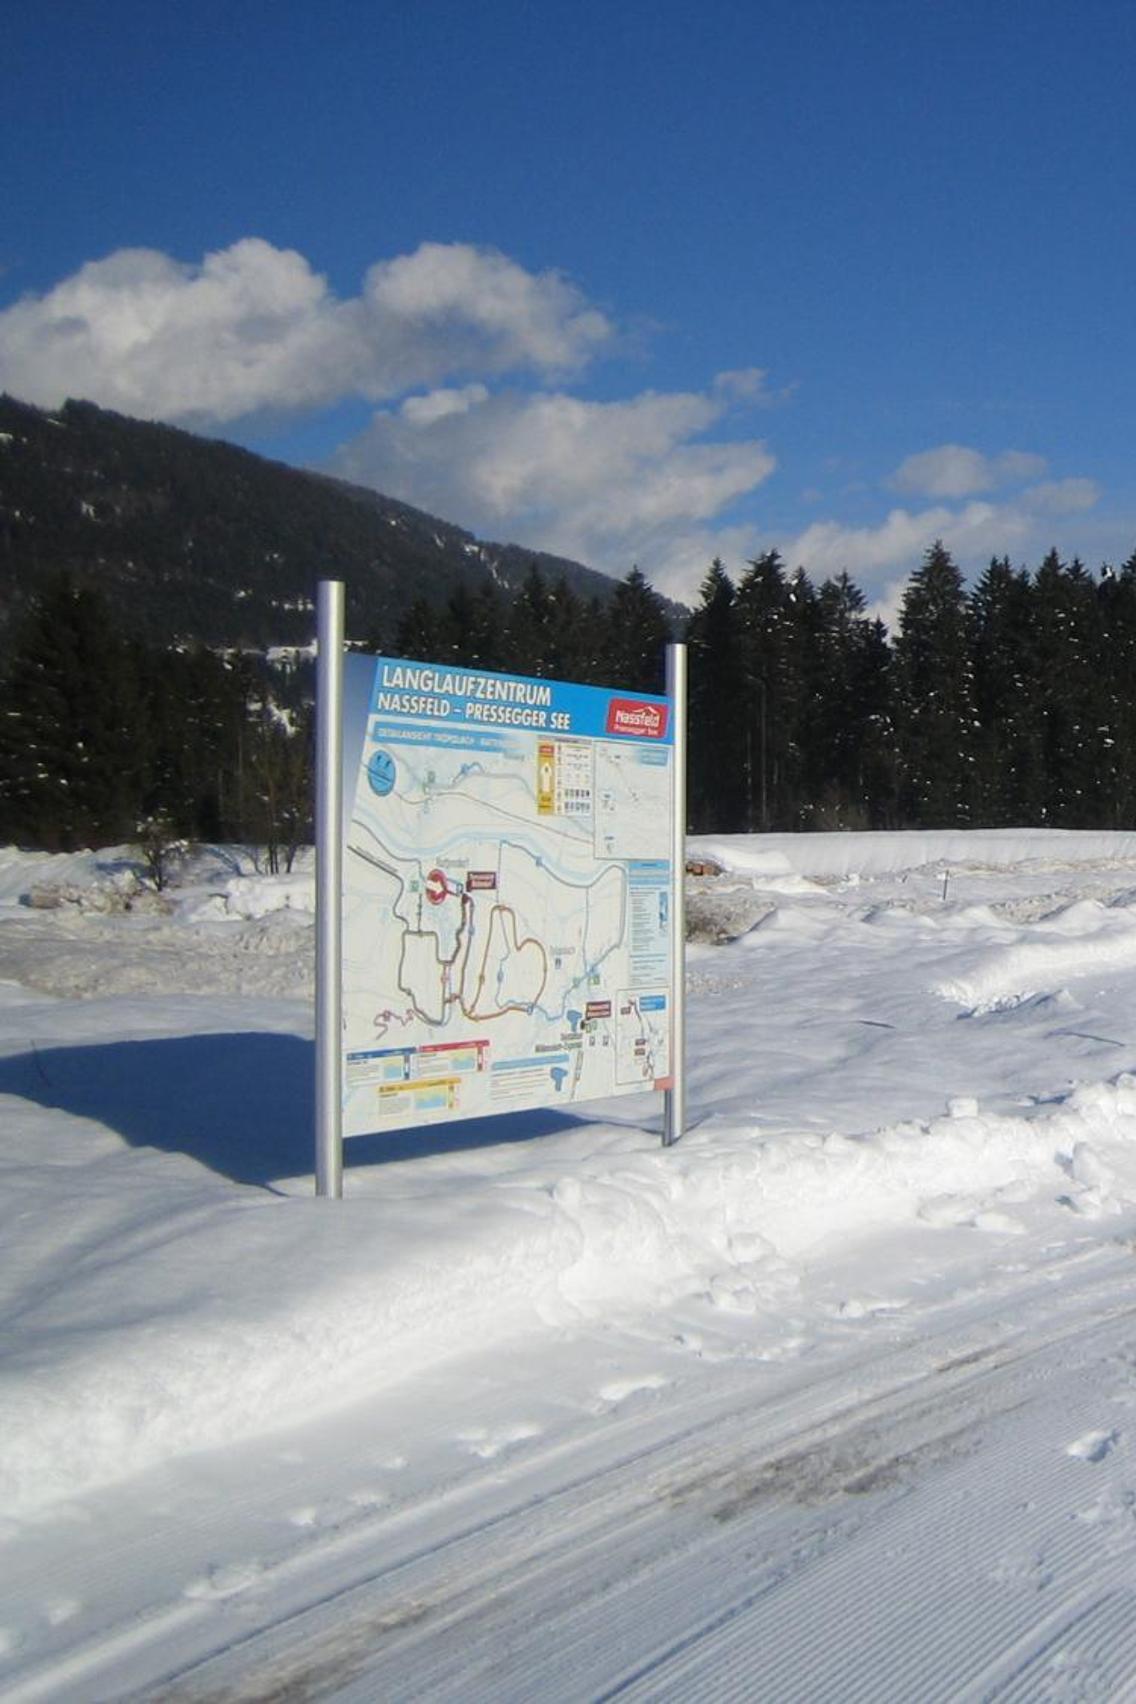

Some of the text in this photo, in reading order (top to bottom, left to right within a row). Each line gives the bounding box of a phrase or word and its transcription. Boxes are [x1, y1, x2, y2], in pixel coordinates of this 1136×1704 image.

[382, 665, 552, 707] LANGLAUFZENTRUM
[377, 692, 451, 718] NASSFELD
[465, 702, 546, 728] PRESSEGGER
[550, 712, 571, 731] SEE
[615, 710, 661, 728] Nassfeld
